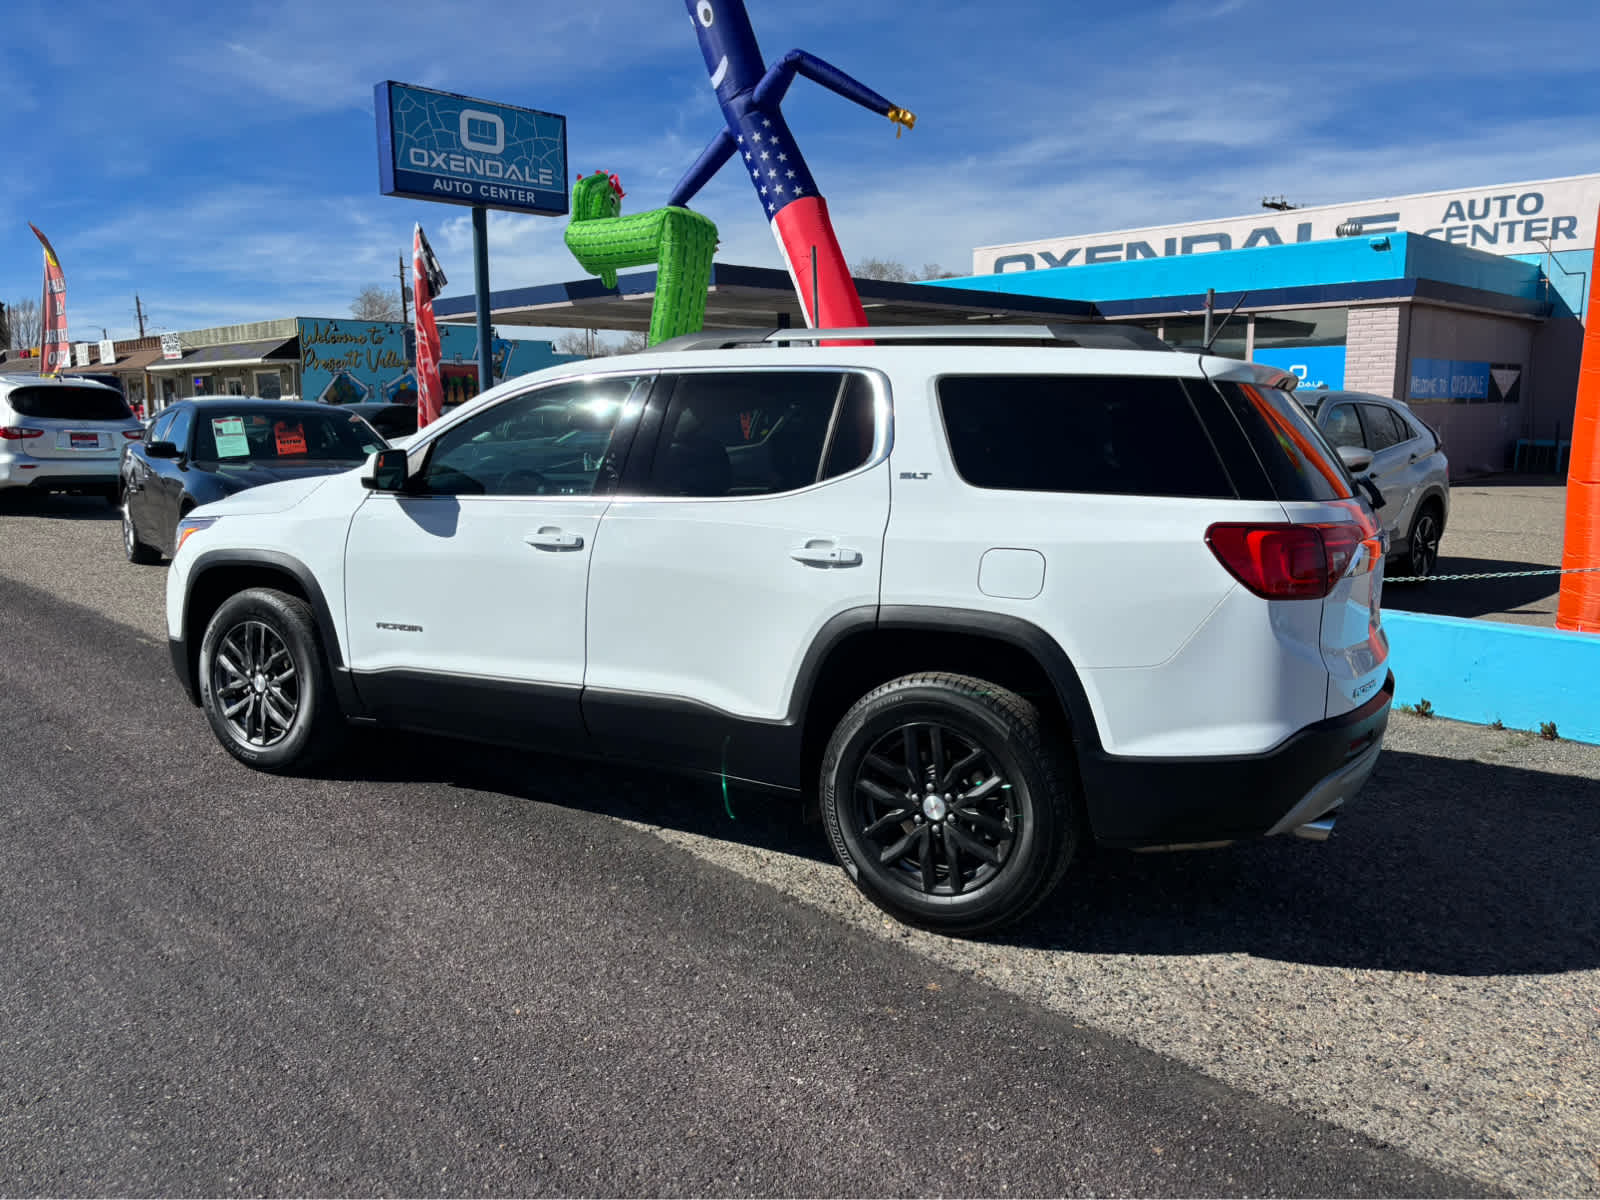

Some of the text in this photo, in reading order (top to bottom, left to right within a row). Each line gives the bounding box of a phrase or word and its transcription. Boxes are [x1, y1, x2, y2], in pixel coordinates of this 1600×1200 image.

[409, 147, 553, 185] OXENDALE
[433, 178, 536, 204] AUTO CENTER
[1441, 191, 1545, 224] AUTO
[300, 322, 384, 348] Welcome to
[300, 347, 410, 374] Prescott Valley
[899, 472, 933, 480] SLT
